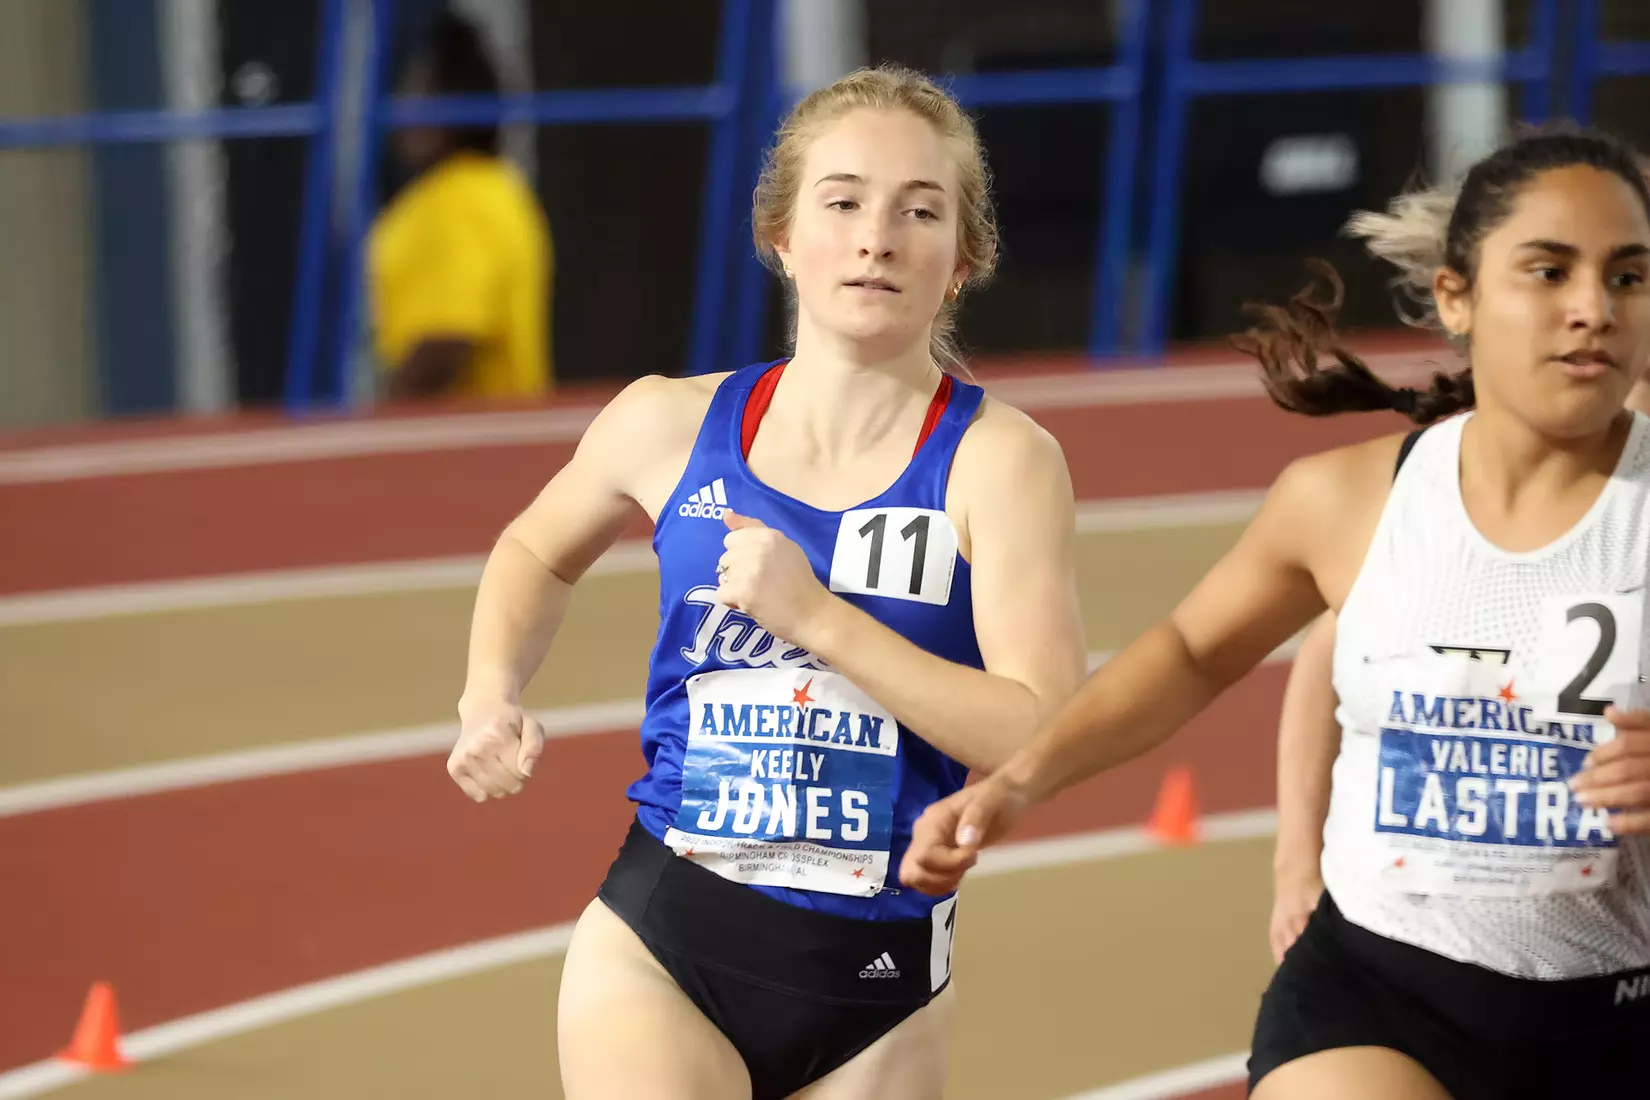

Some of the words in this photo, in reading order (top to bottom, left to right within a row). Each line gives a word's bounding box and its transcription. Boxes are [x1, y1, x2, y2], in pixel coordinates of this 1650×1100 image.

[679, 502, 733, 520] adida
[858, 514, 930, 595] 11
[1558, 602, 1616, 716] 2
[699, 703, 884, 748] AMERICAN
[1388, 690, 1596, 743] AMERICAN
[751, 749, 825, 782] KEELY
[1432, 740, 1561, 778] VALERIE
[696, 775, 870, 842] JONES
[738, 862, 795, 873] BIRMINGH
[859, 969, 900, 979] adidas
[1613, 975, 1650, 1006] NI
